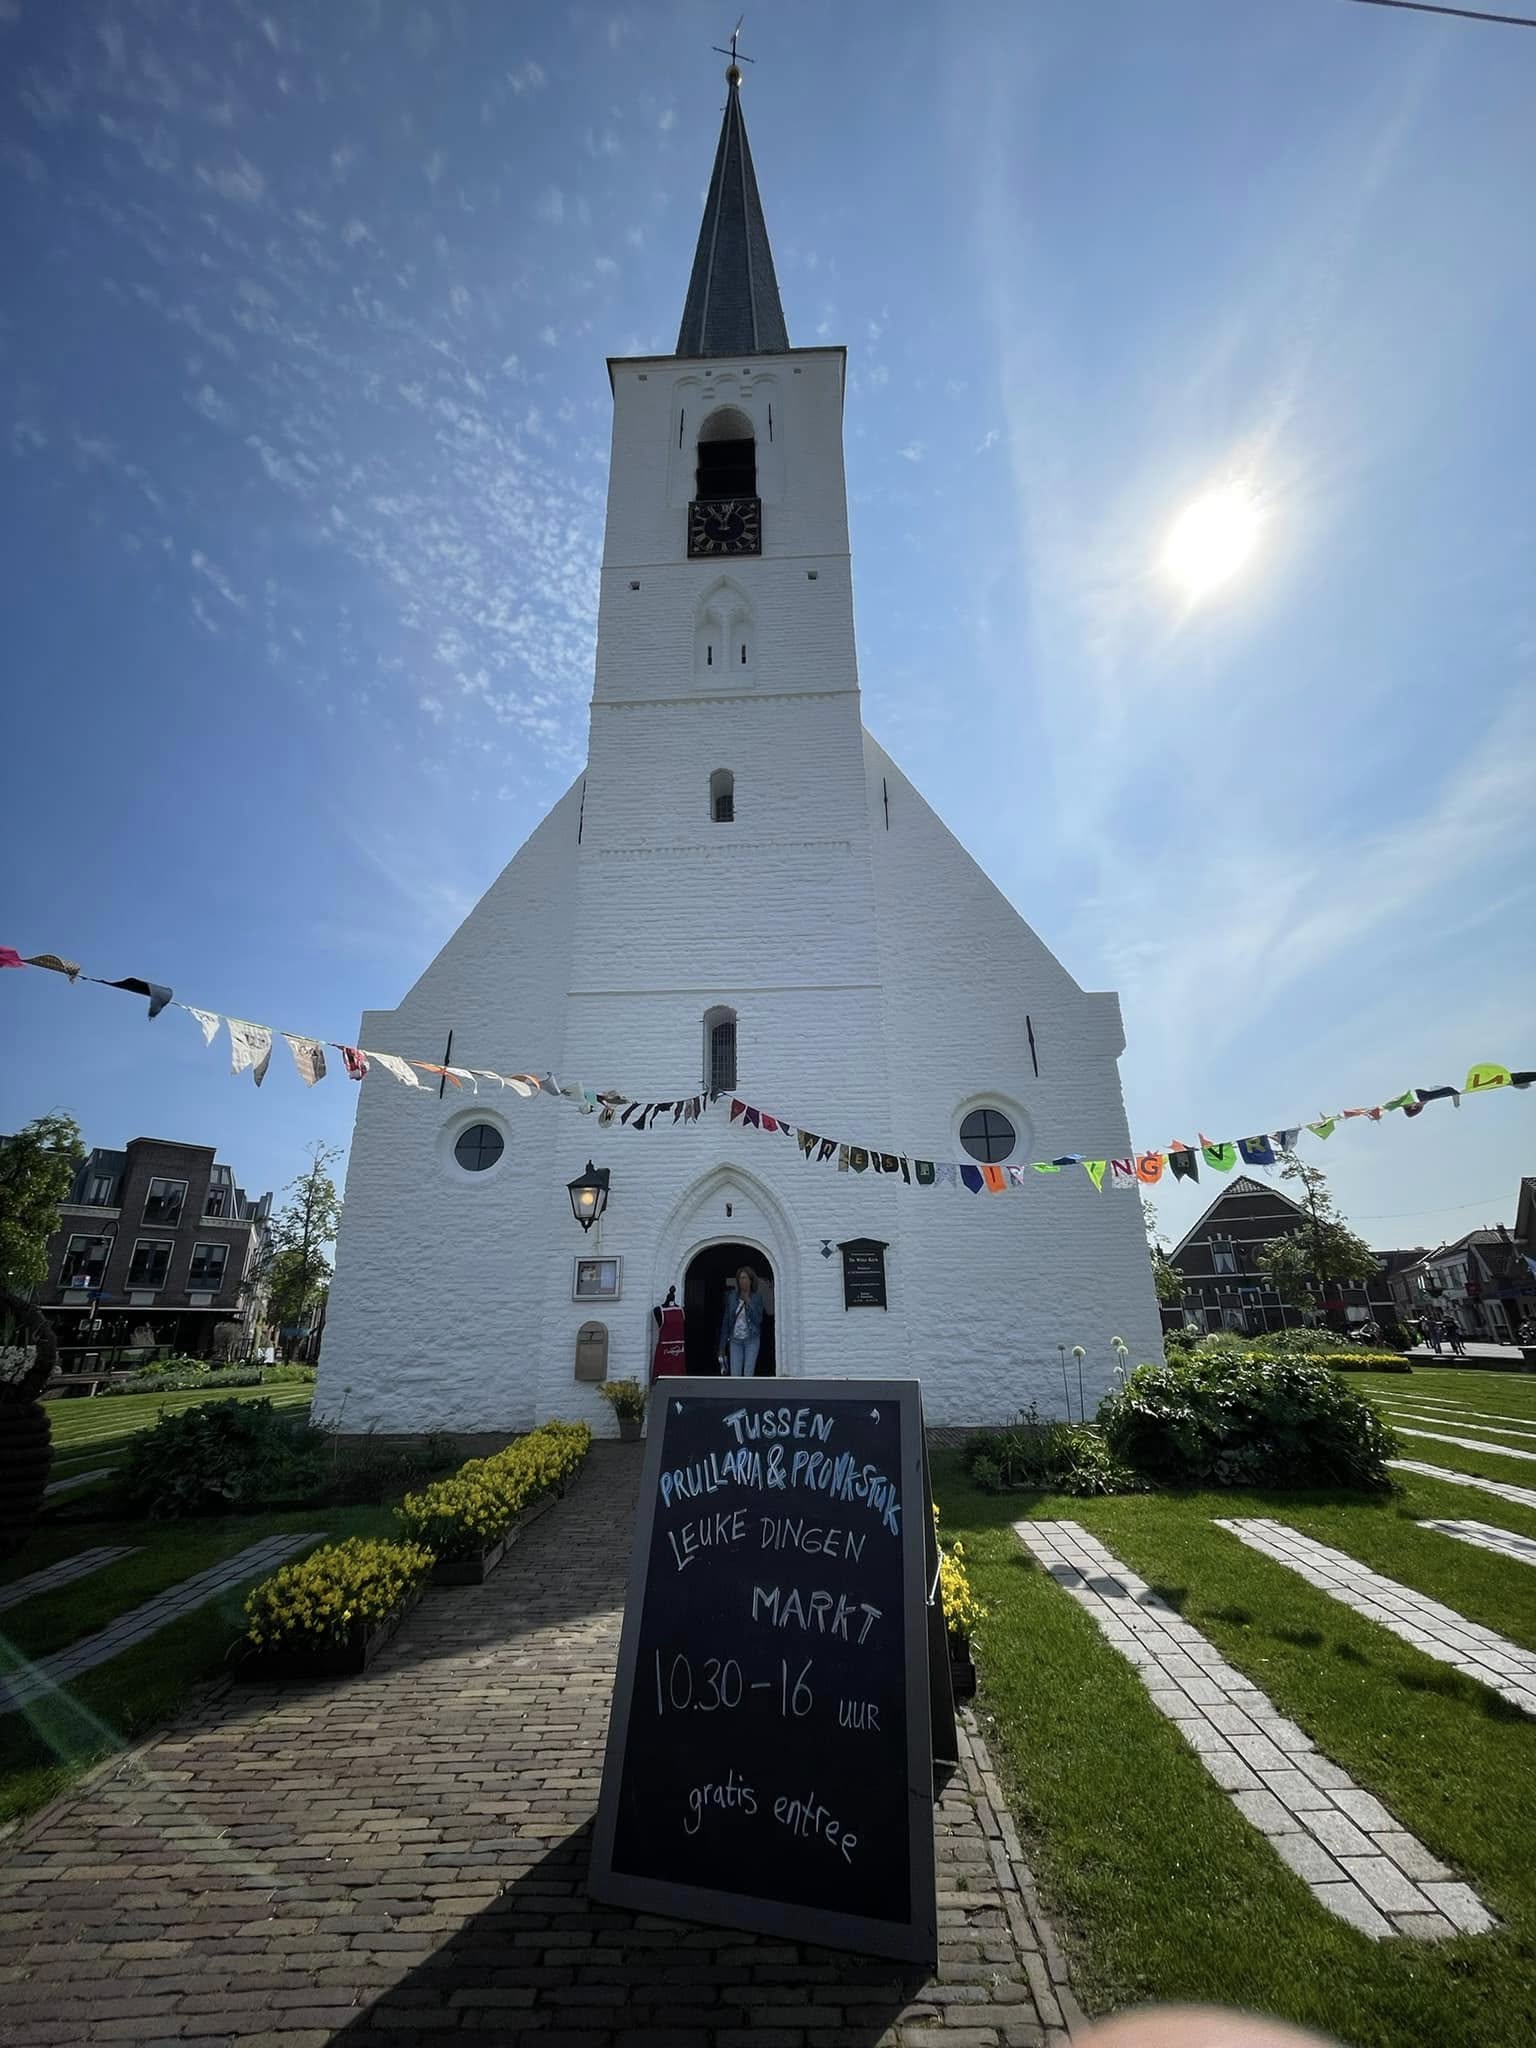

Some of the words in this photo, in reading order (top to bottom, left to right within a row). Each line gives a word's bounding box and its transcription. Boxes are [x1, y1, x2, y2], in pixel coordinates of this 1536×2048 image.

[722, 1407, 834, 1444] TUSSEN
[659, 1447, 763, 1508] PRULLARIA
[766, 1443, 787, 1491] &
[790, 1450, 902, 1536] PRONKSTUK
[668, 1508, 748, 1571] LEUKE
[760, 1517, 866, 1563] DINGEN
[752, 1586, 882, 1645] MARKT
[838, 1699, 881, 1731] UUR
[684, 1769, 757, 1834] gratis
[774, 1792, 857, 1864] entree
